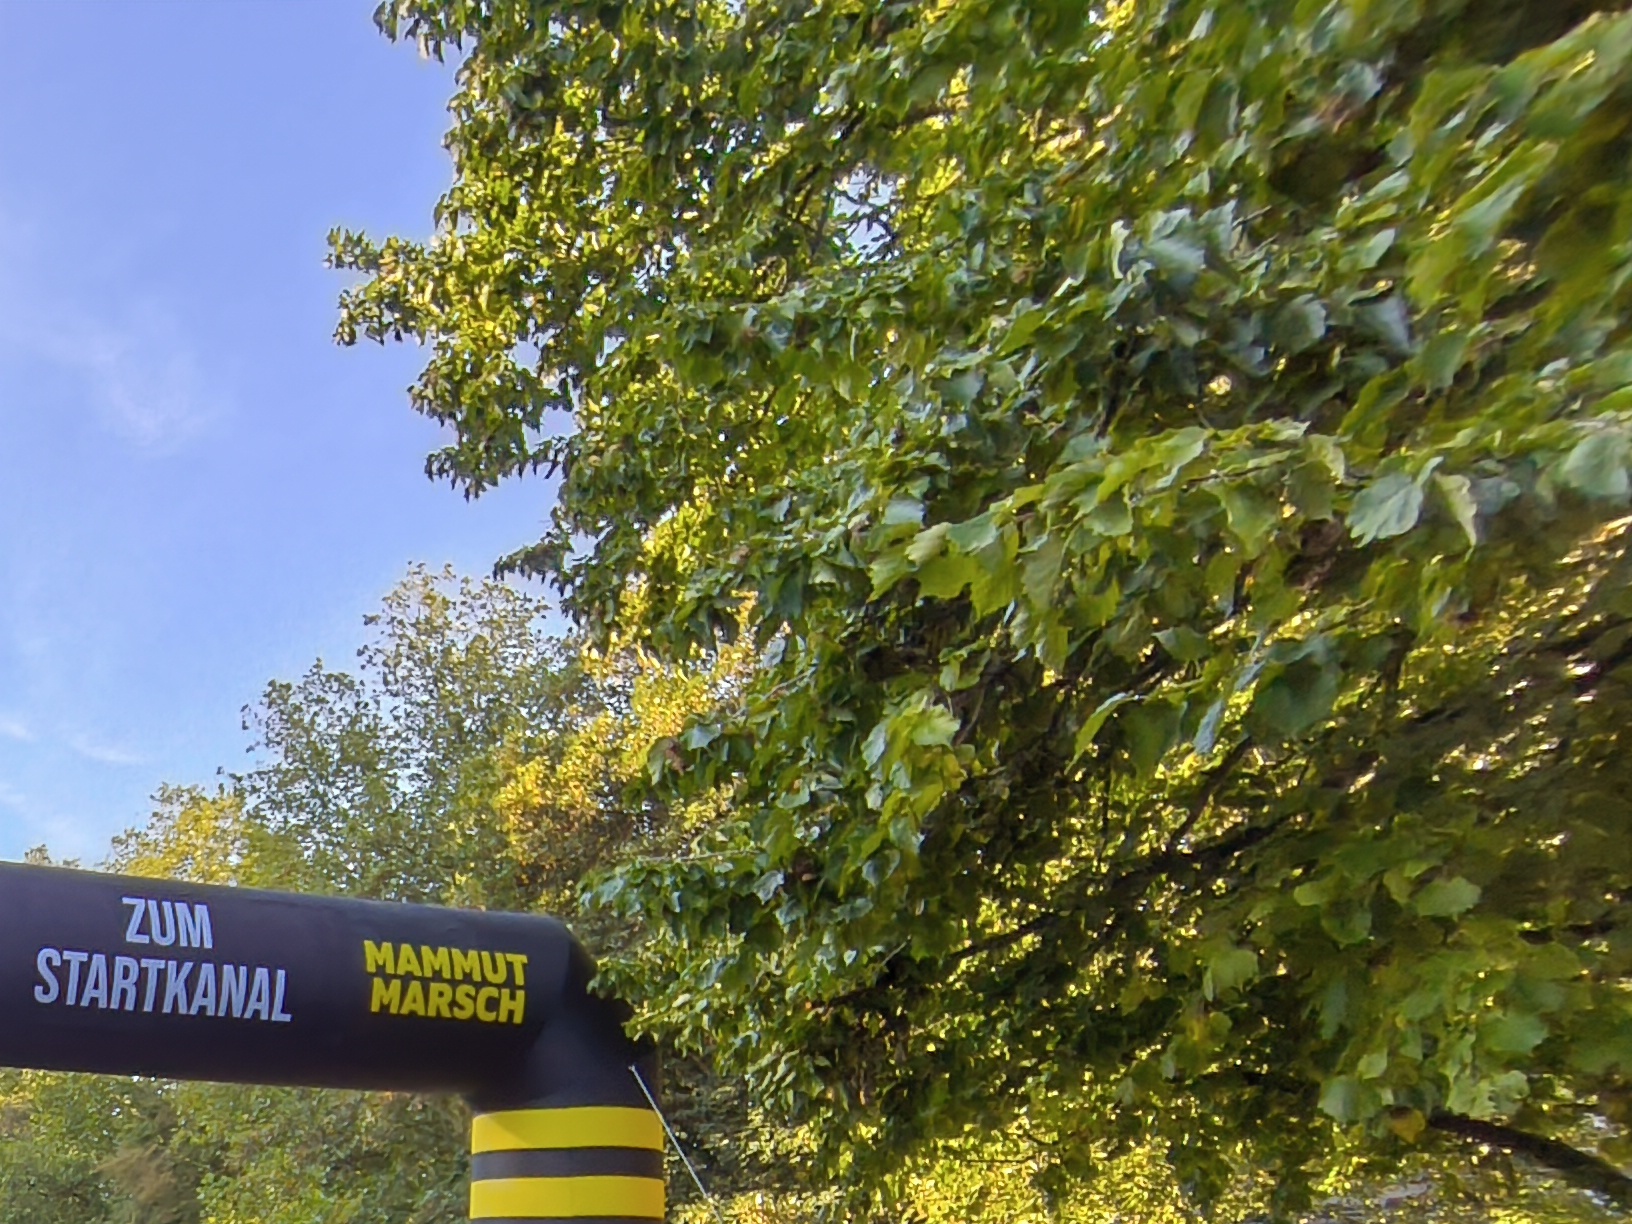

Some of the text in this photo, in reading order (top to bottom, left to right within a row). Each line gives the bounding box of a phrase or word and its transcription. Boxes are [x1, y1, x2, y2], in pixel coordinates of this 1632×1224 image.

[122, 897, 214, 949] ZUM
[34, 948, 292, 1022] STARTKANAL
[364, 939, 528, 986] MAMMUT
[371, 977, 525, 1024] MARSCH
